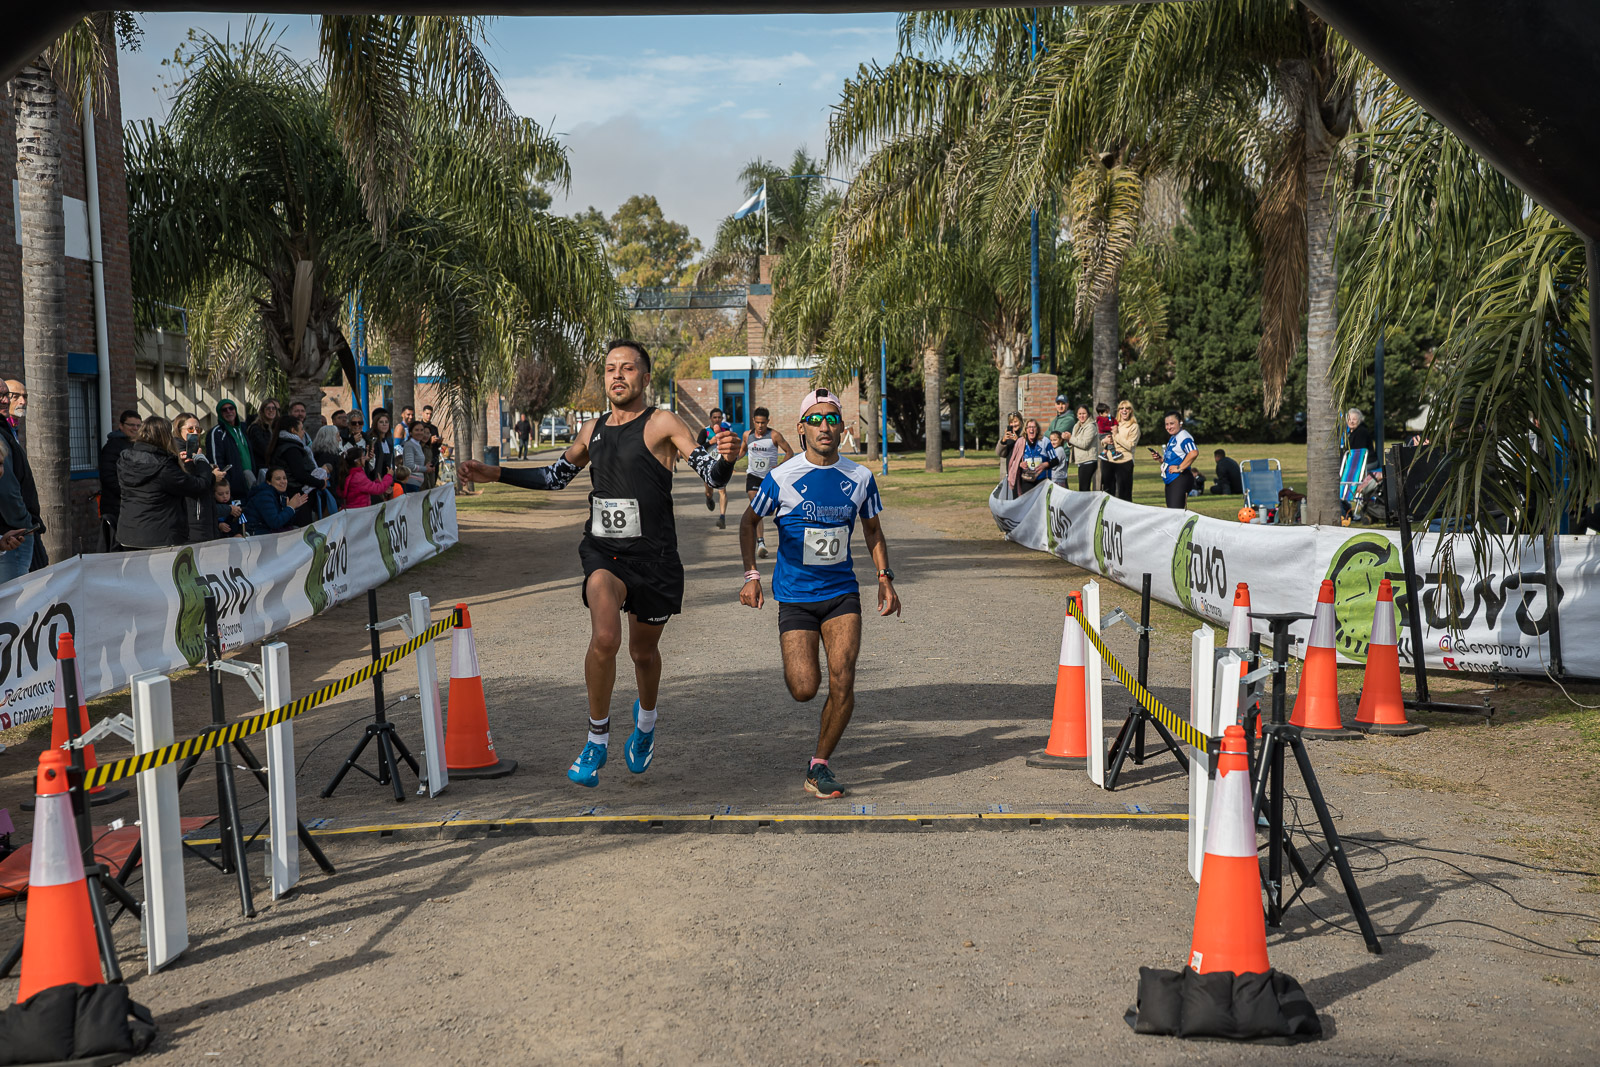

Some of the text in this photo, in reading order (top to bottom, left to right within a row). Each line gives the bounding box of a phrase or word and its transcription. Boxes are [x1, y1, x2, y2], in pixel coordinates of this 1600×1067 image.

[754, 461, 766, 469] 70
[601, 510, 627, 529] 88
[802, 500, 817, 523] 3
[815, 538, 840, 556] 20
[1454, 639, 1530, 659] @cronorav
